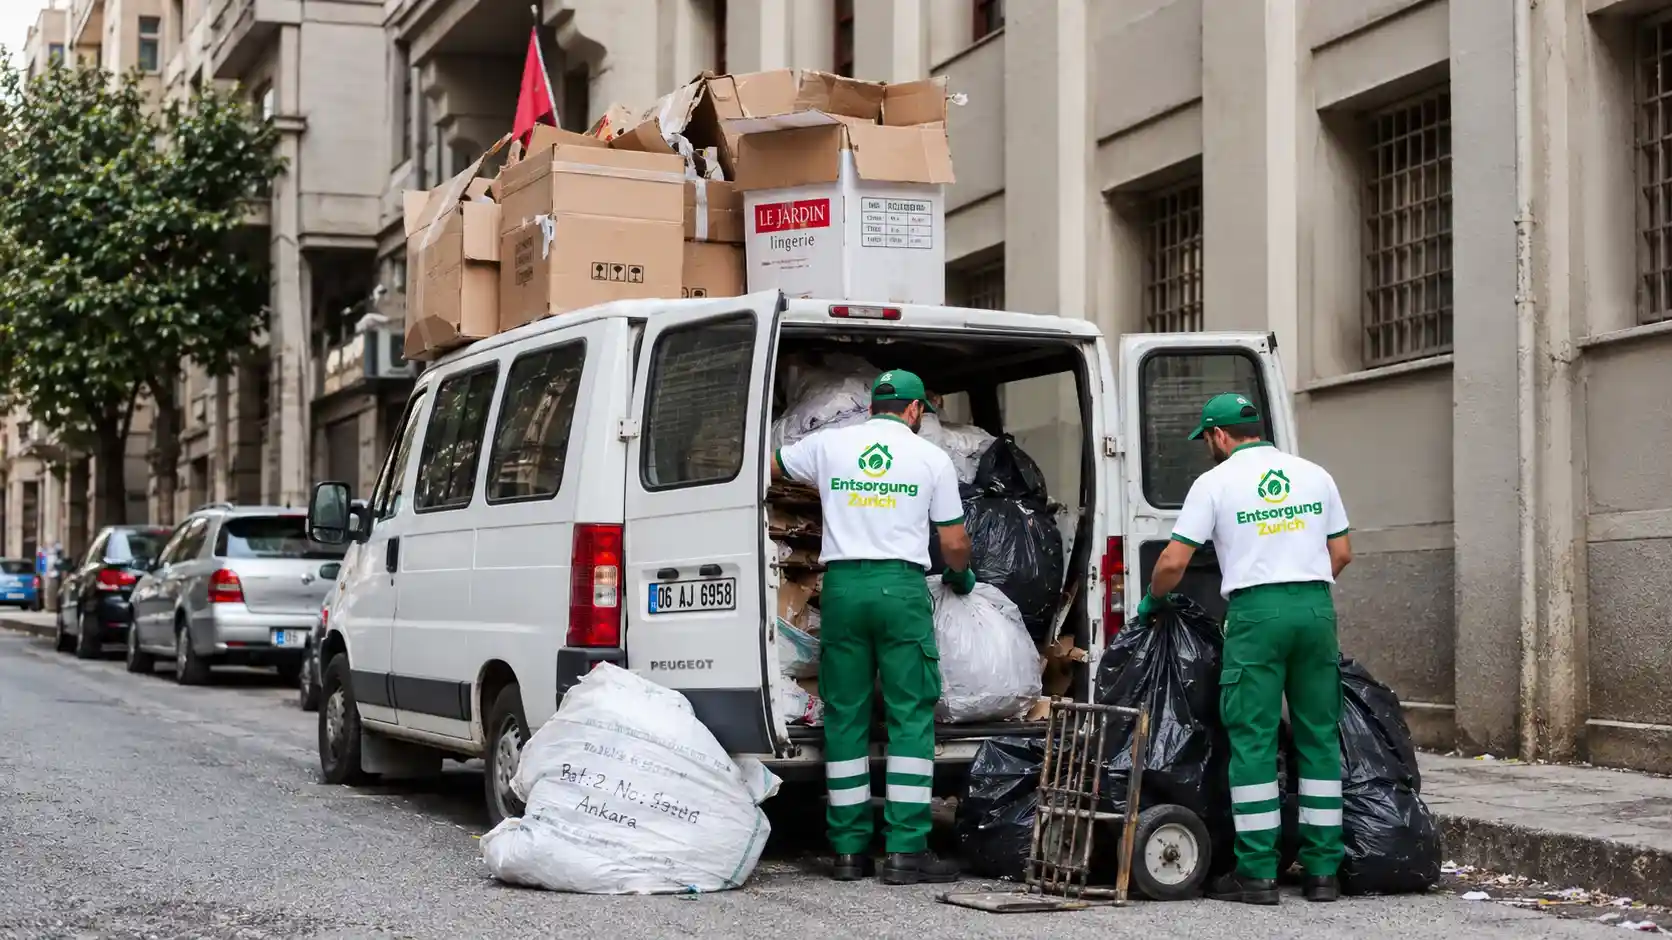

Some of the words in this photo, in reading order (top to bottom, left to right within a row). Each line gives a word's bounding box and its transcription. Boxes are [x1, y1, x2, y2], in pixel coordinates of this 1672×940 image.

[759, 209, 774, 227] LE
[776, 204, 826, 229] JARDIN
[770, 232, 815, 252] lingerie
[830, 477, 919, 497] Entsorgung
[847, 492, 897, 509] Zurich
[1236, 501, 1323, 525] Entsorgung
[1257, 517, 1305, 537] Zurich
[658, 586, 672, 609] 06
[679, 584, 694, 609] AJ
[700, 582, 732, 607] 6958
[650, 659, 714, 671] PEUGEOT
[575, 795, 637, 829] Ankara
